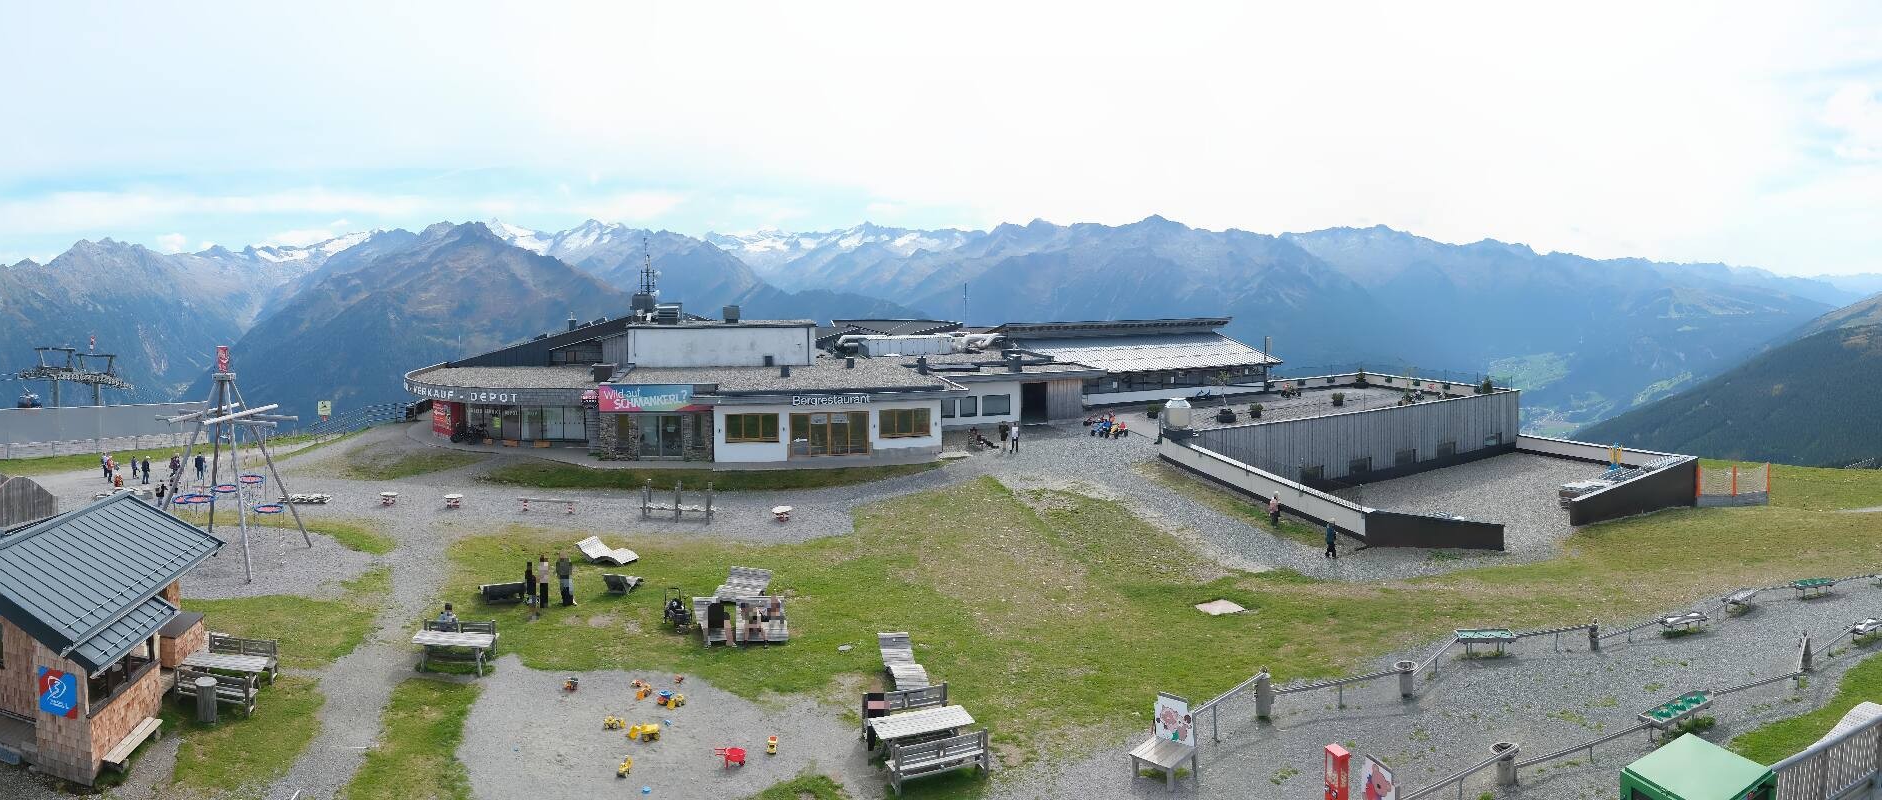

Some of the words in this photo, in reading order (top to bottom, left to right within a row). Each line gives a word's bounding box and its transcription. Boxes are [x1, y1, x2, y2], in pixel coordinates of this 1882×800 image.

[414, 386, 454, 399] VERKAUF
[470, 392, 518, 403] DEPOT
[603, 388, 624, 400] Wild
[626, 387, 641, 398] auf
[614, 390, 688, 410] SCHMANKERL?
[792, 394, 870, 406] Bergrestaurant
